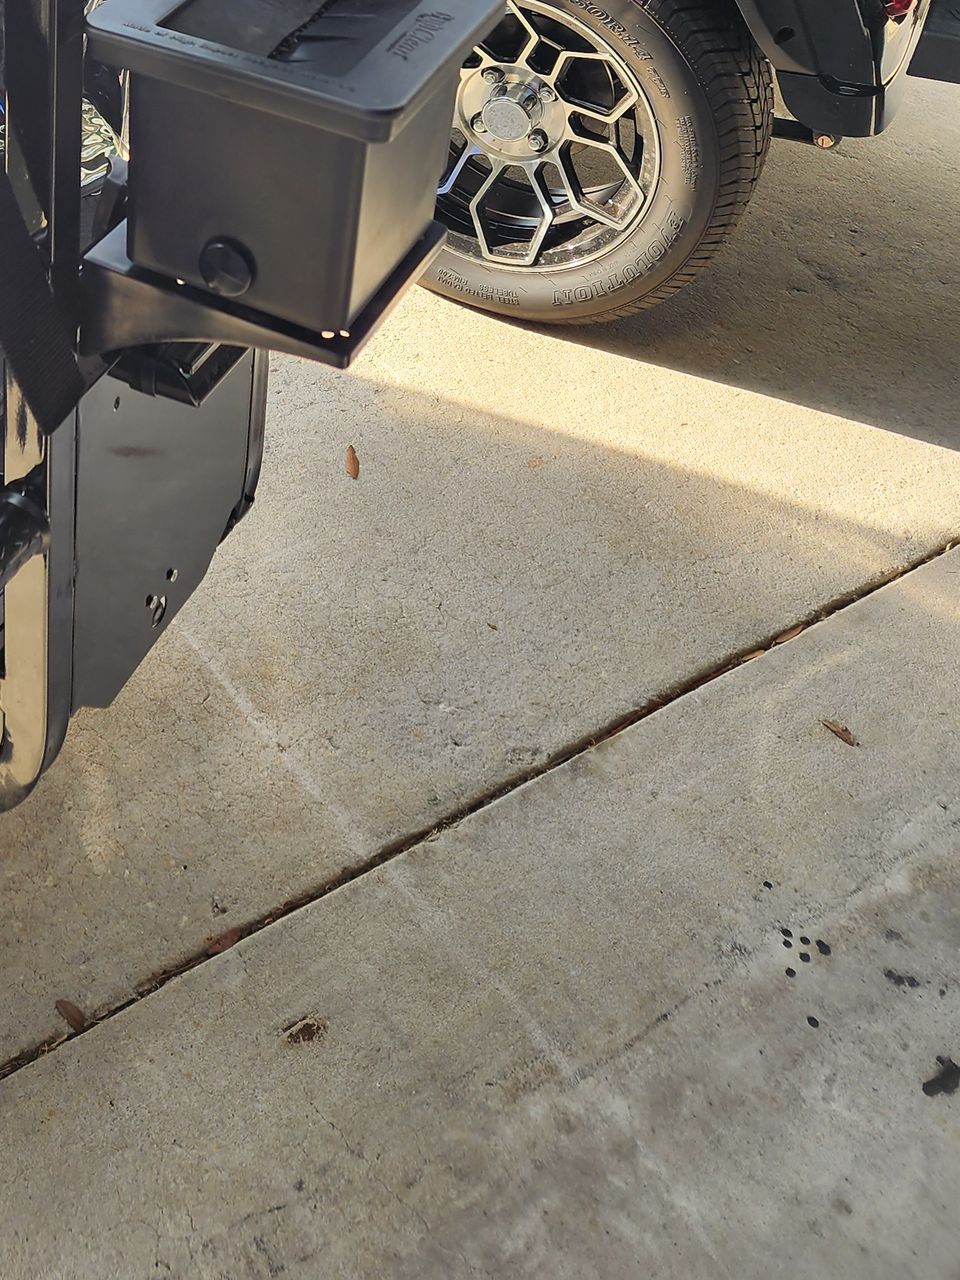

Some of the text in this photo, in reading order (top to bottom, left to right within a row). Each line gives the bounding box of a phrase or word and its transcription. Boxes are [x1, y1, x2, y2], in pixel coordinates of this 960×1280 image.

[552, 211, 685, 305] EVOLUTION
[465, 288, 493, 301] BELTED
[497, 295, 520, 305] STEEL
